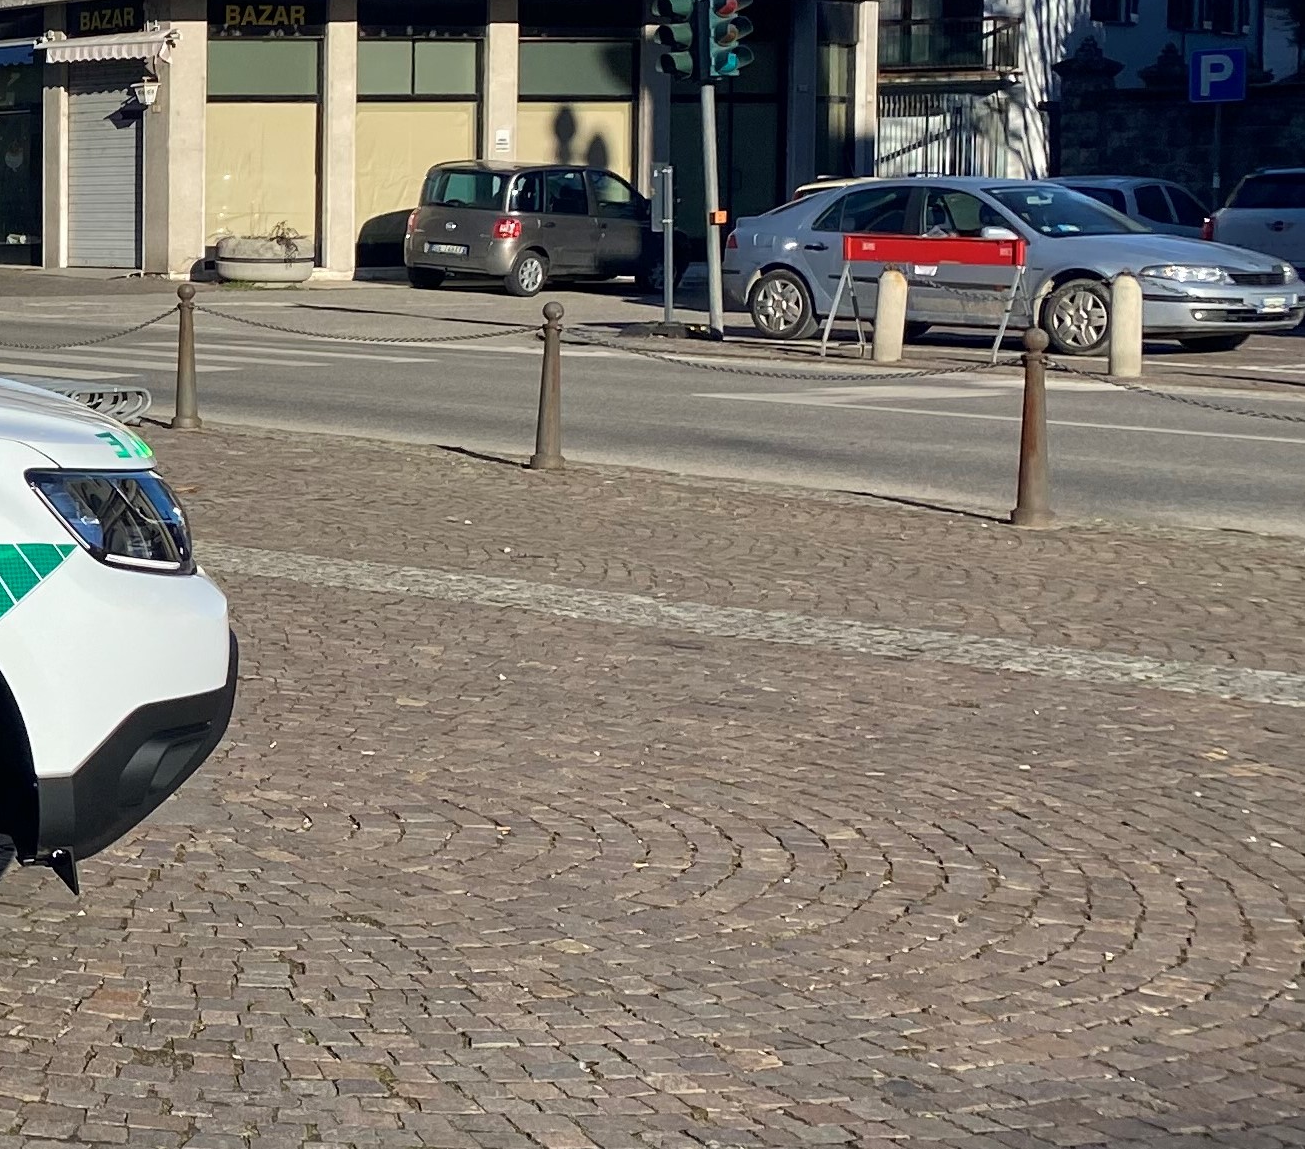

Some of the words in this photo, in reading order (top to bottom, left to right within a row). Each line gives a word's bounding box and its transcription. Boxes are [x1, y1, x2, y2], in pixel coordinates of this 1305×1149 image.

[79, 6, 136, 31] BAZAR
[224, 4, 306, 26] BAZAR
[1200, 54, 1234, 97] P
